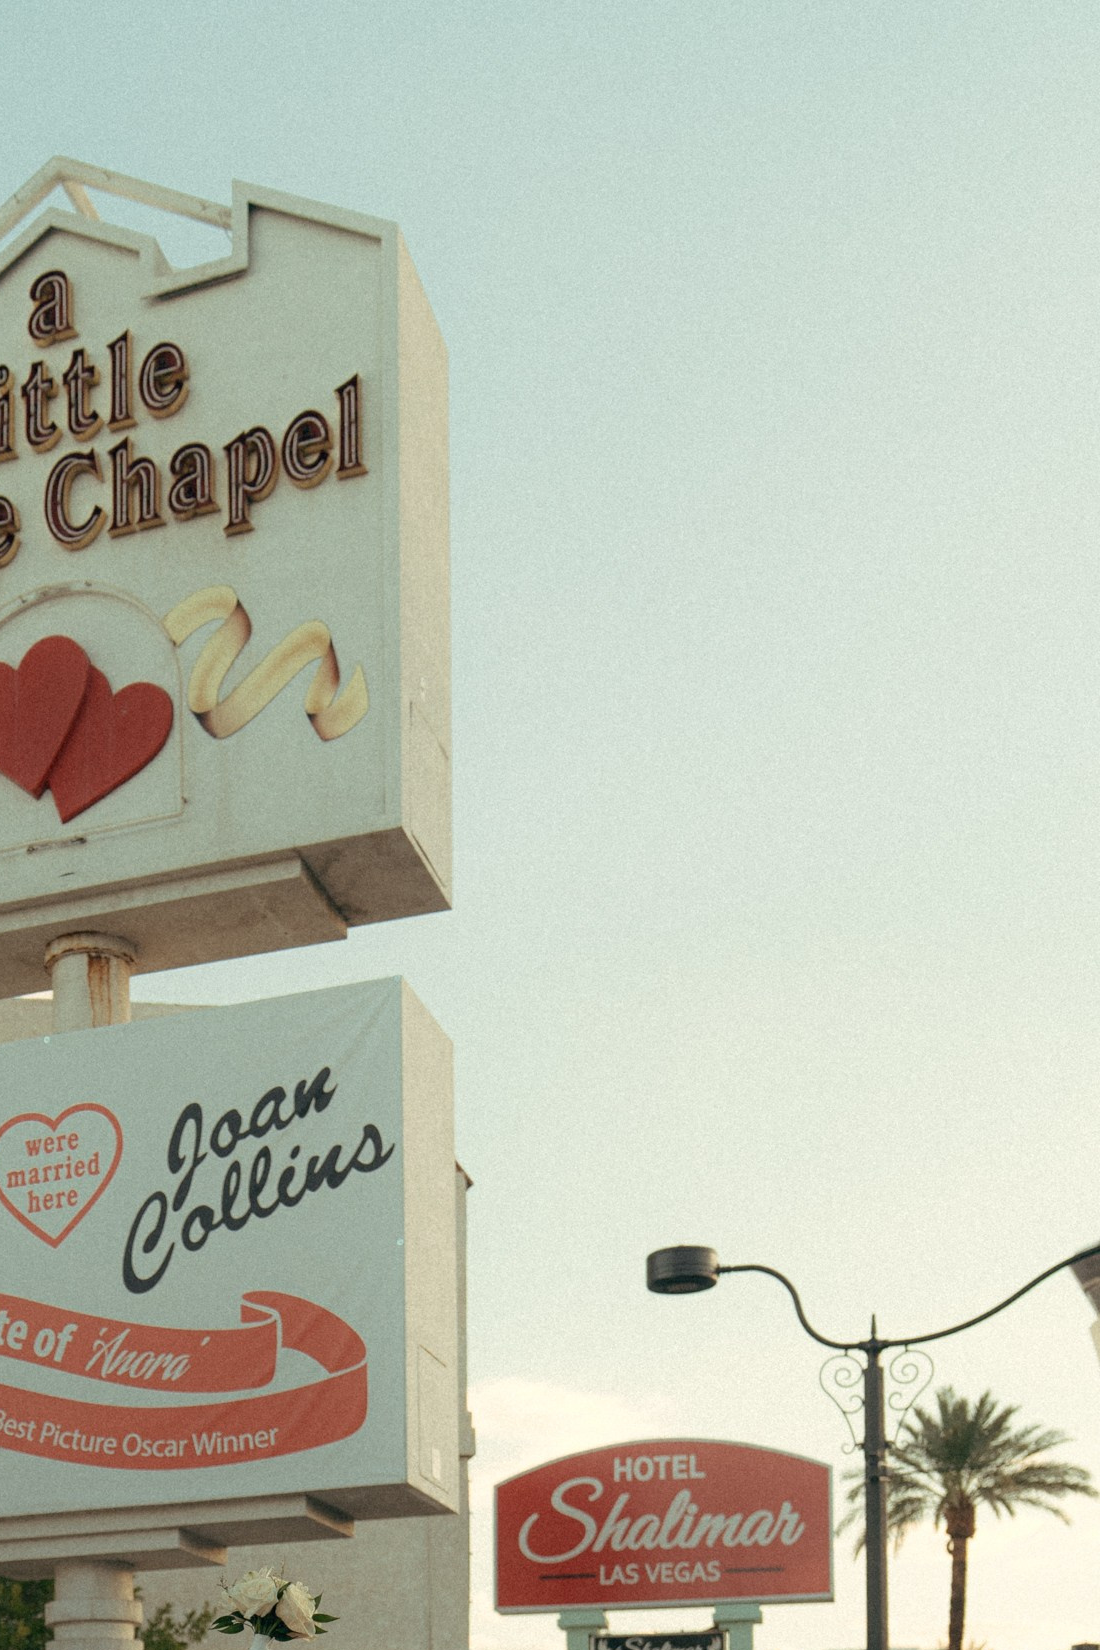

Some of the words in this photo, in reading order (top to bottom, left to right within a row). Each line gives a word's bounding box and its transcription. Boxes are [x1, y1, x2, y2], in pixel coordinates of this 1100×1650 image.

[28, 270, 79, 347] a
[44, 373, 369, 552] Chapel
[25, 1131, 80, 1157] were
[167, 1066, 338, 1212] Joan
[6, 1151, 101, 1188] married
[26, 1188, 79, 1214] here
[122, 1123, 396, 1294] Collins
[32, 1323, 79, 1363] of
[39, 1421, 117, 1455] Picture
[122, 1432, 188, 1457] Oscar
[191, 1427, 279, 1457] Winner
[613, 1454, 706, 1482] HOTEL
[518, 1476, 805, 1564] Shalimar
[600, 1563, 639, 1585] LAS
[645, 1560, 722, 1584] VEGAS
